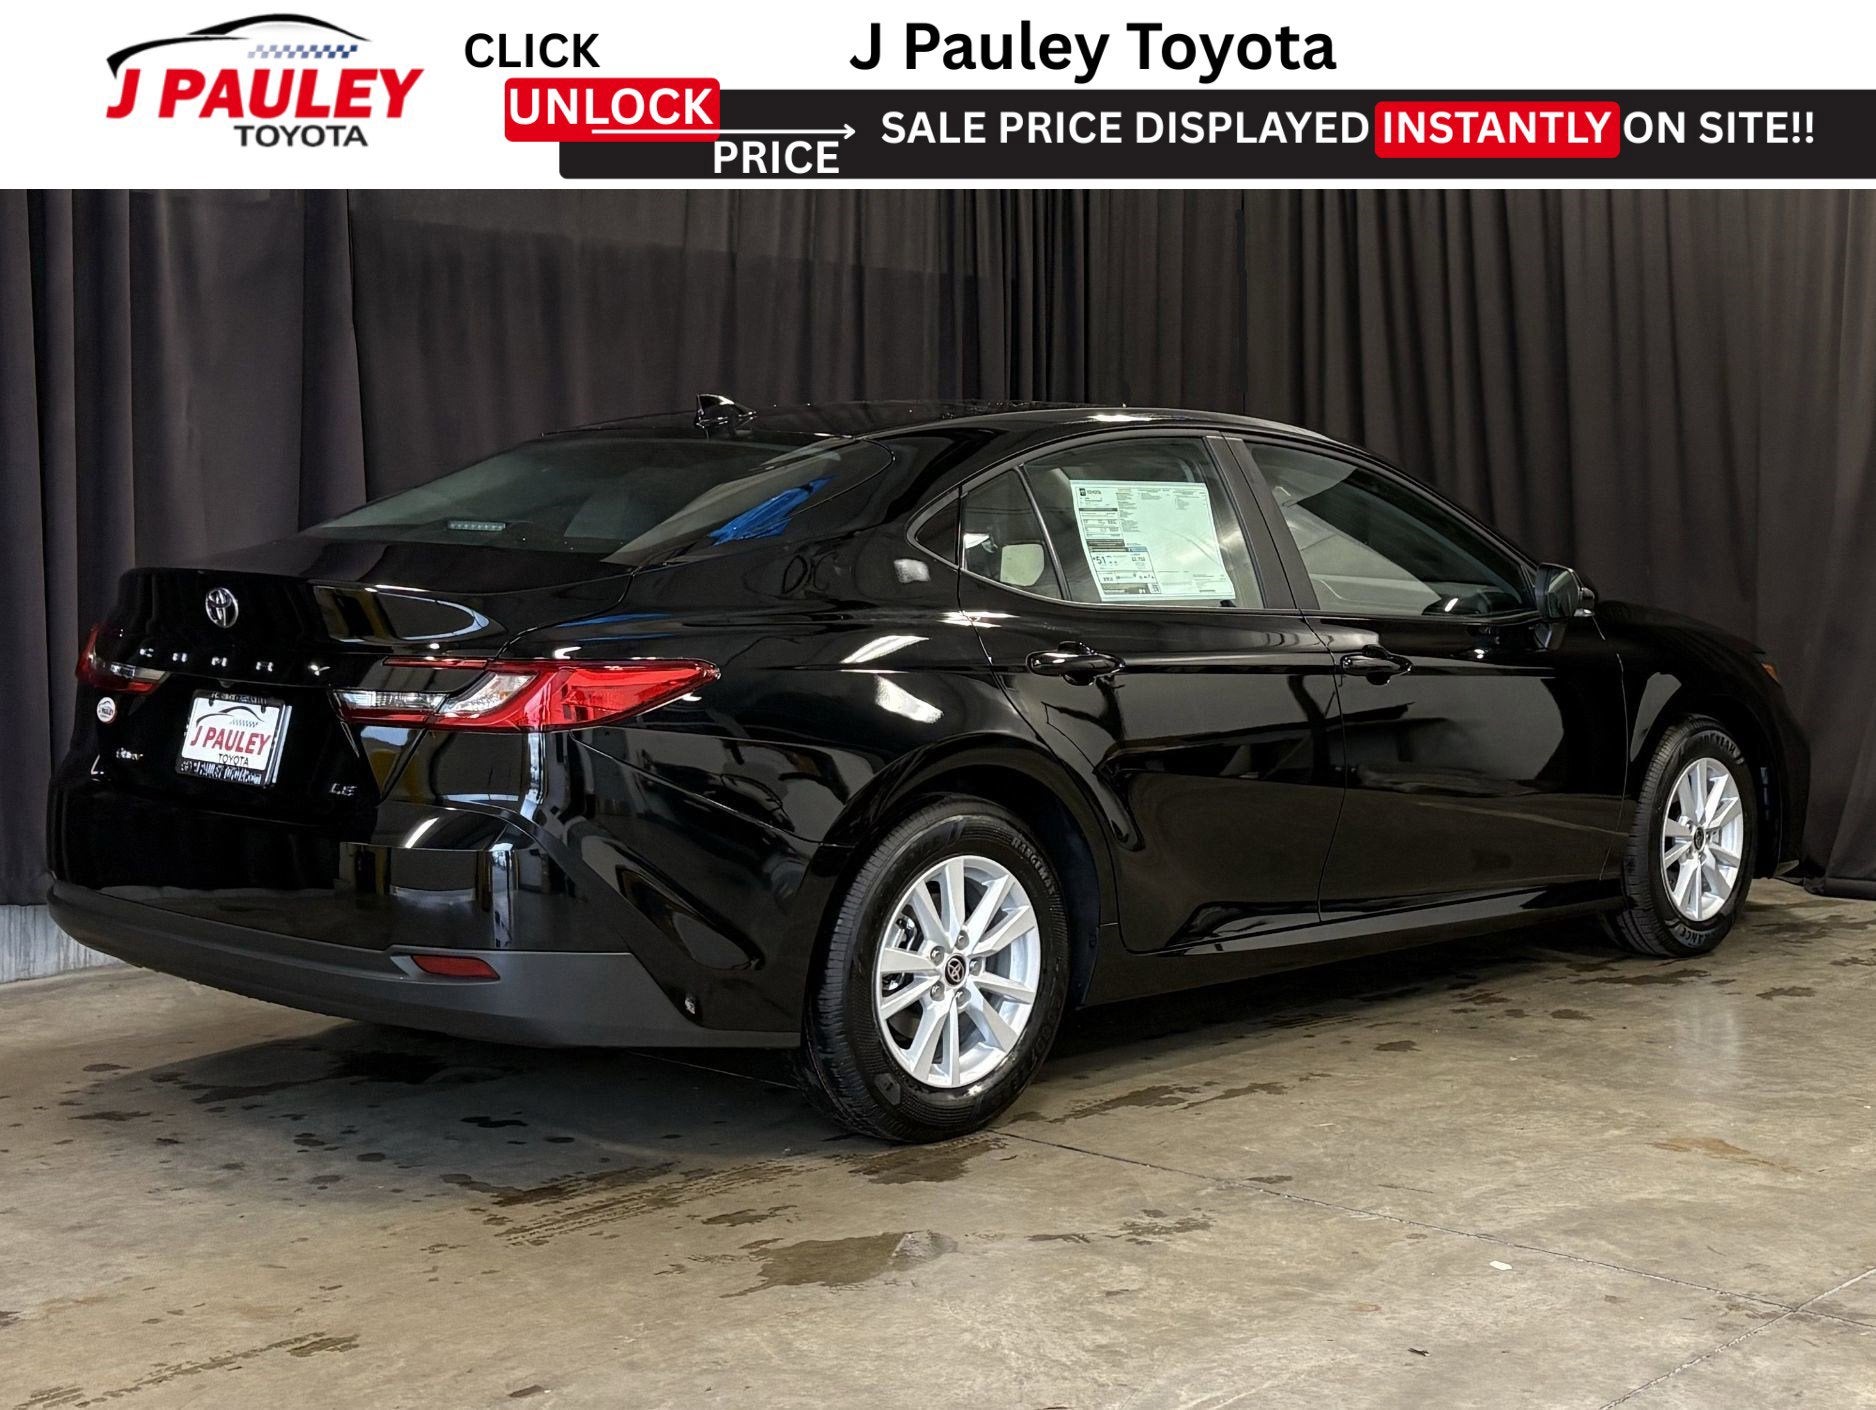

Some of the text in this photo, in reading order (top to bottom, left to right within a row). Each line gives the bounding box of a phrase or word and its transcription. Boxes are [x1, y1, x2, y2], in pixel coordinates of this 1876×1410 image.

[190, 725, 272, 755] J PAULEY
[218, 753, 249, 767] TOYOTA
